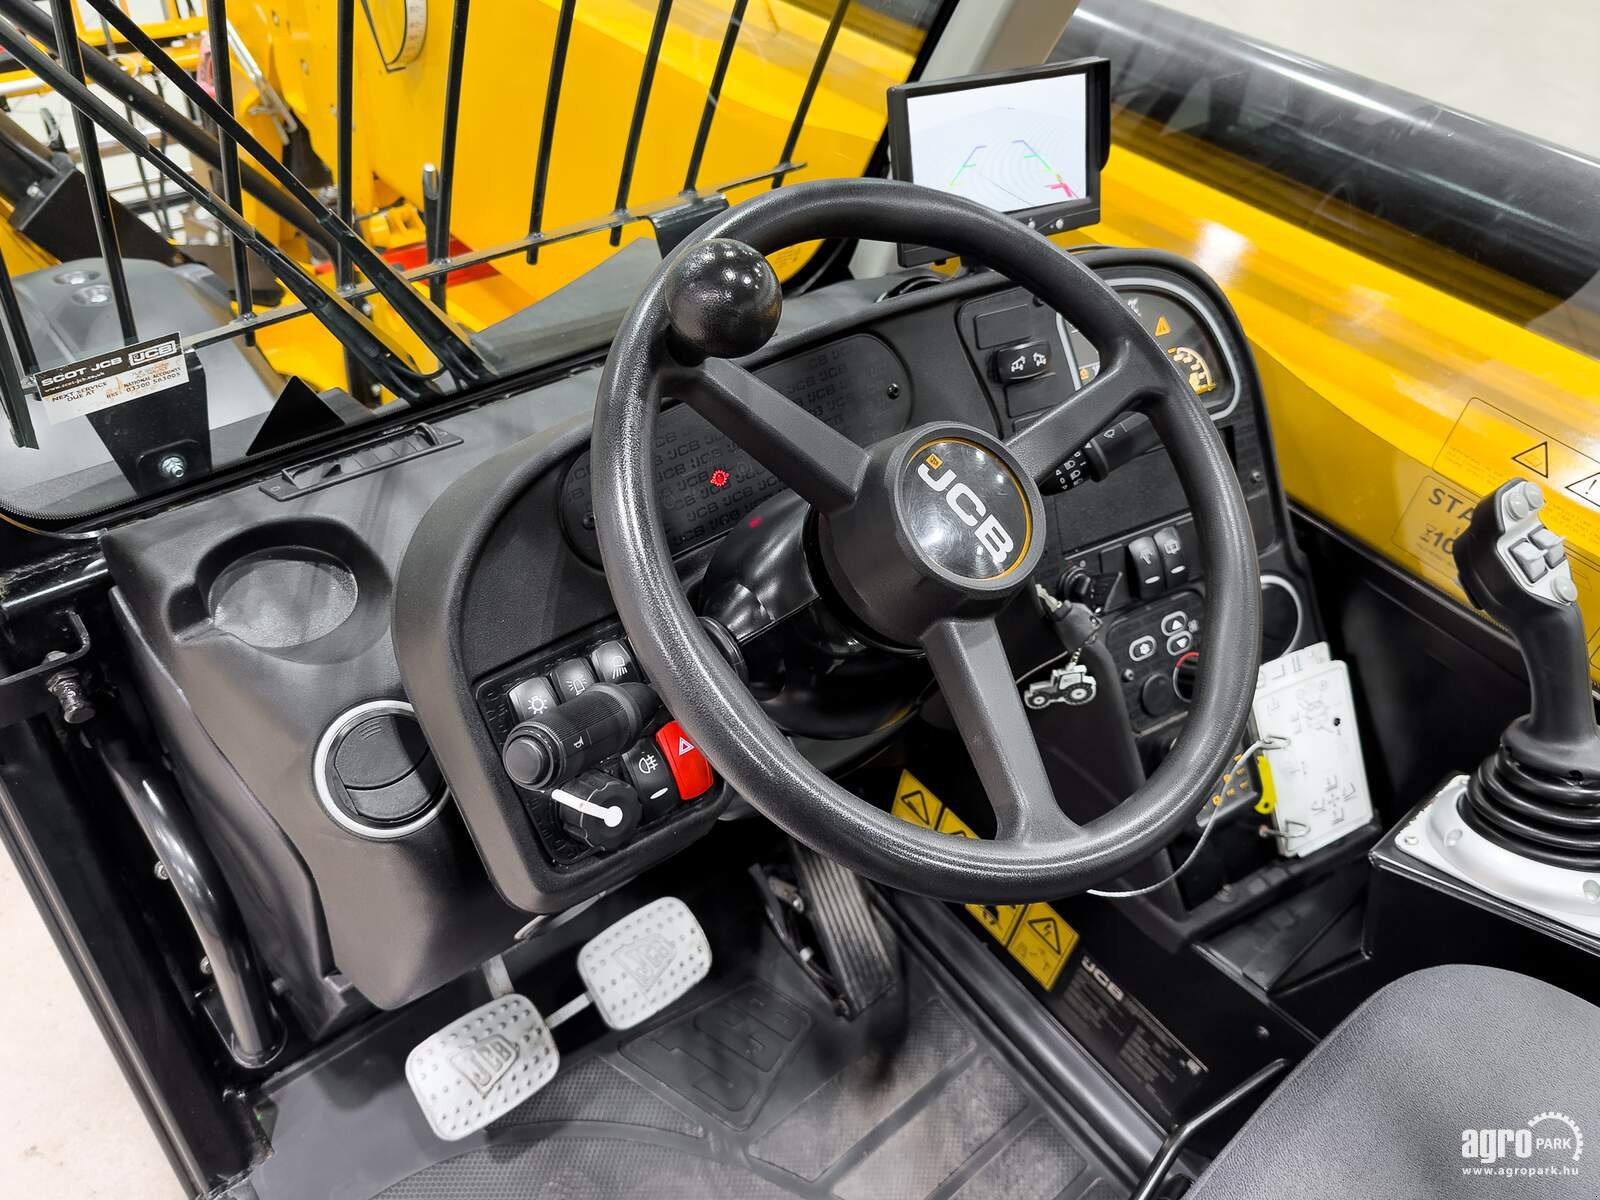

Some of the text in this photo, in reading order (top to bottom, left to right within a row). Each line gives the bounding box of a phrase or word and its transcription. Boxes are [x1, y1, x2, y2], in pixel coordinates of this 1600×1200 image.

[131, 342, 175, 364] JCB
[41, 368, 88, 387] SCOT
[91, 356, 123, 372] JCB
[52, 381, 108, 402] NEXT SERVICE
[67, 392, 84, 402] DUE
[916, 456, 1015, 566] JCB
[1081, 955, 1124, 1001] JCB
